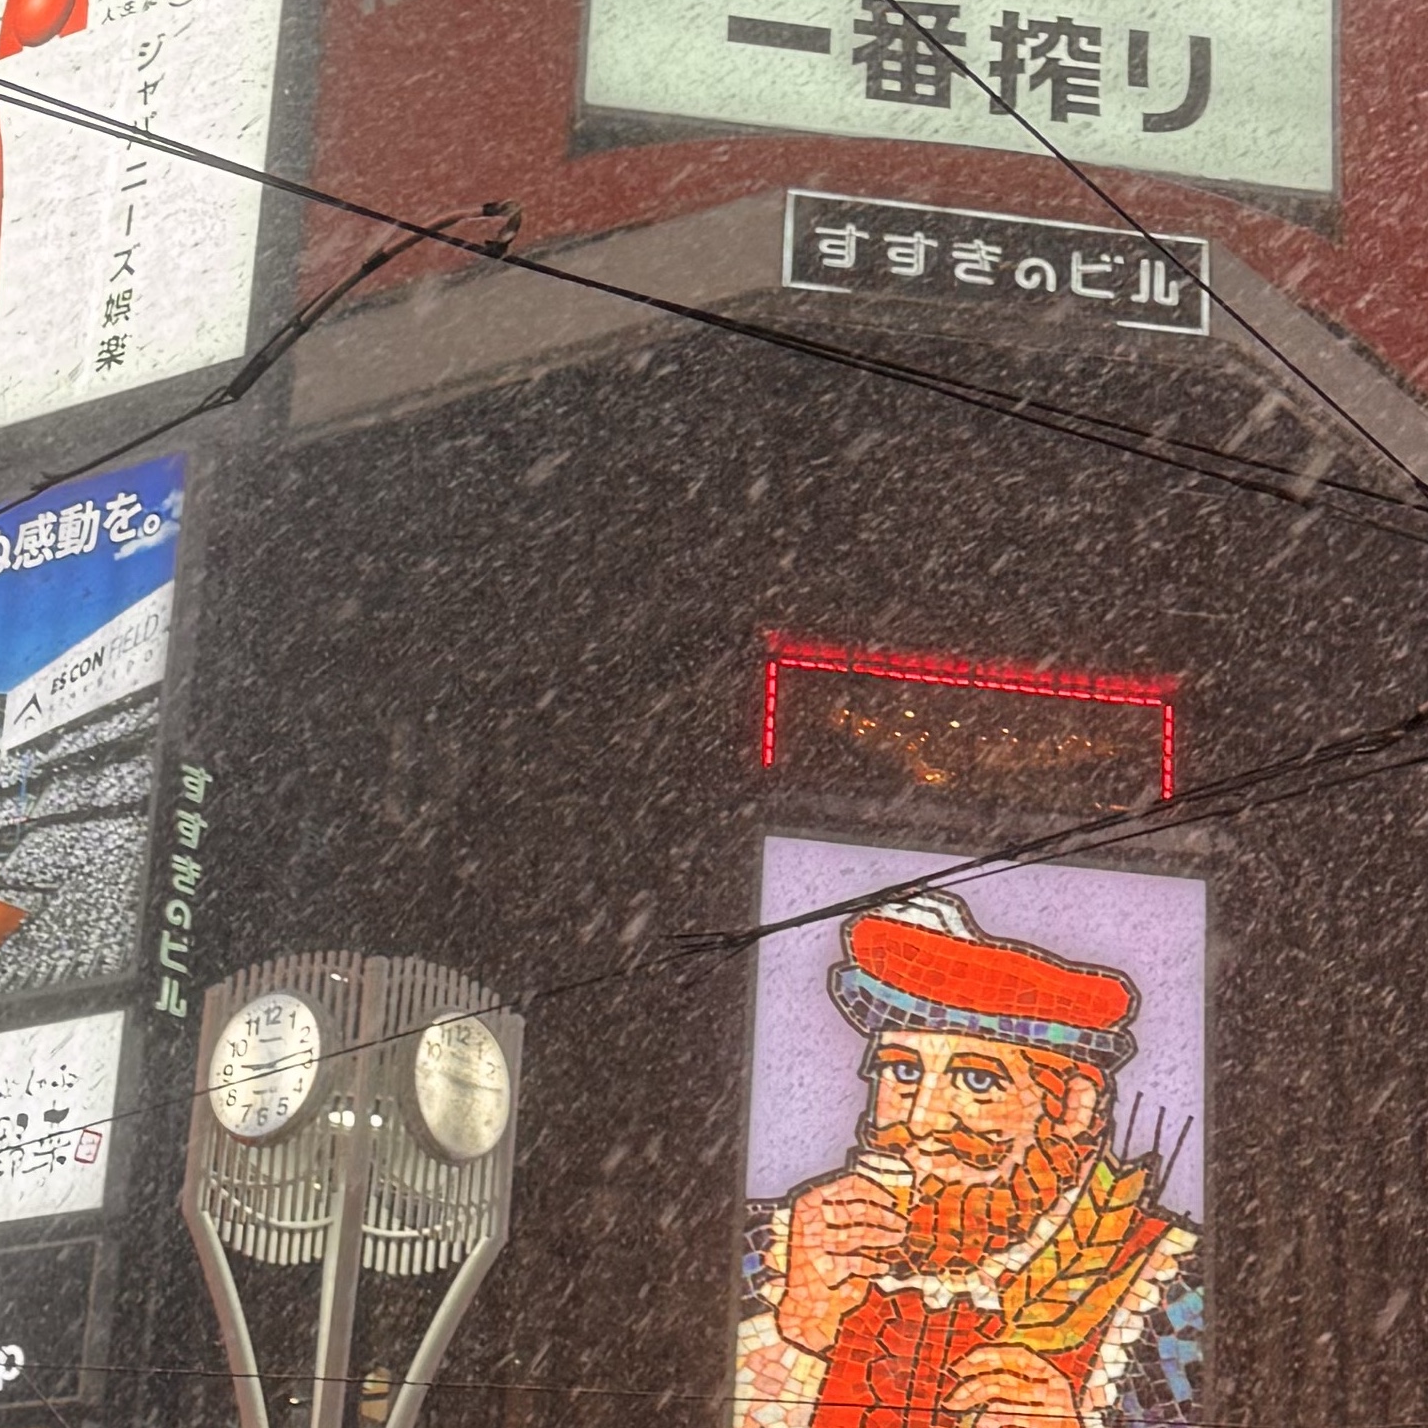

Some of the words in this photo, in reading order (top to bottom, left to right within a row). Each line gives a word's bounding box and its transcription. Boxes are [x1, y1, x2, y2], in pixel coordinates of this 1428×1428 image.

[812, 220, 1182, 308] すすきのビル
[155, 762, 214, 1019] すすきのビル
